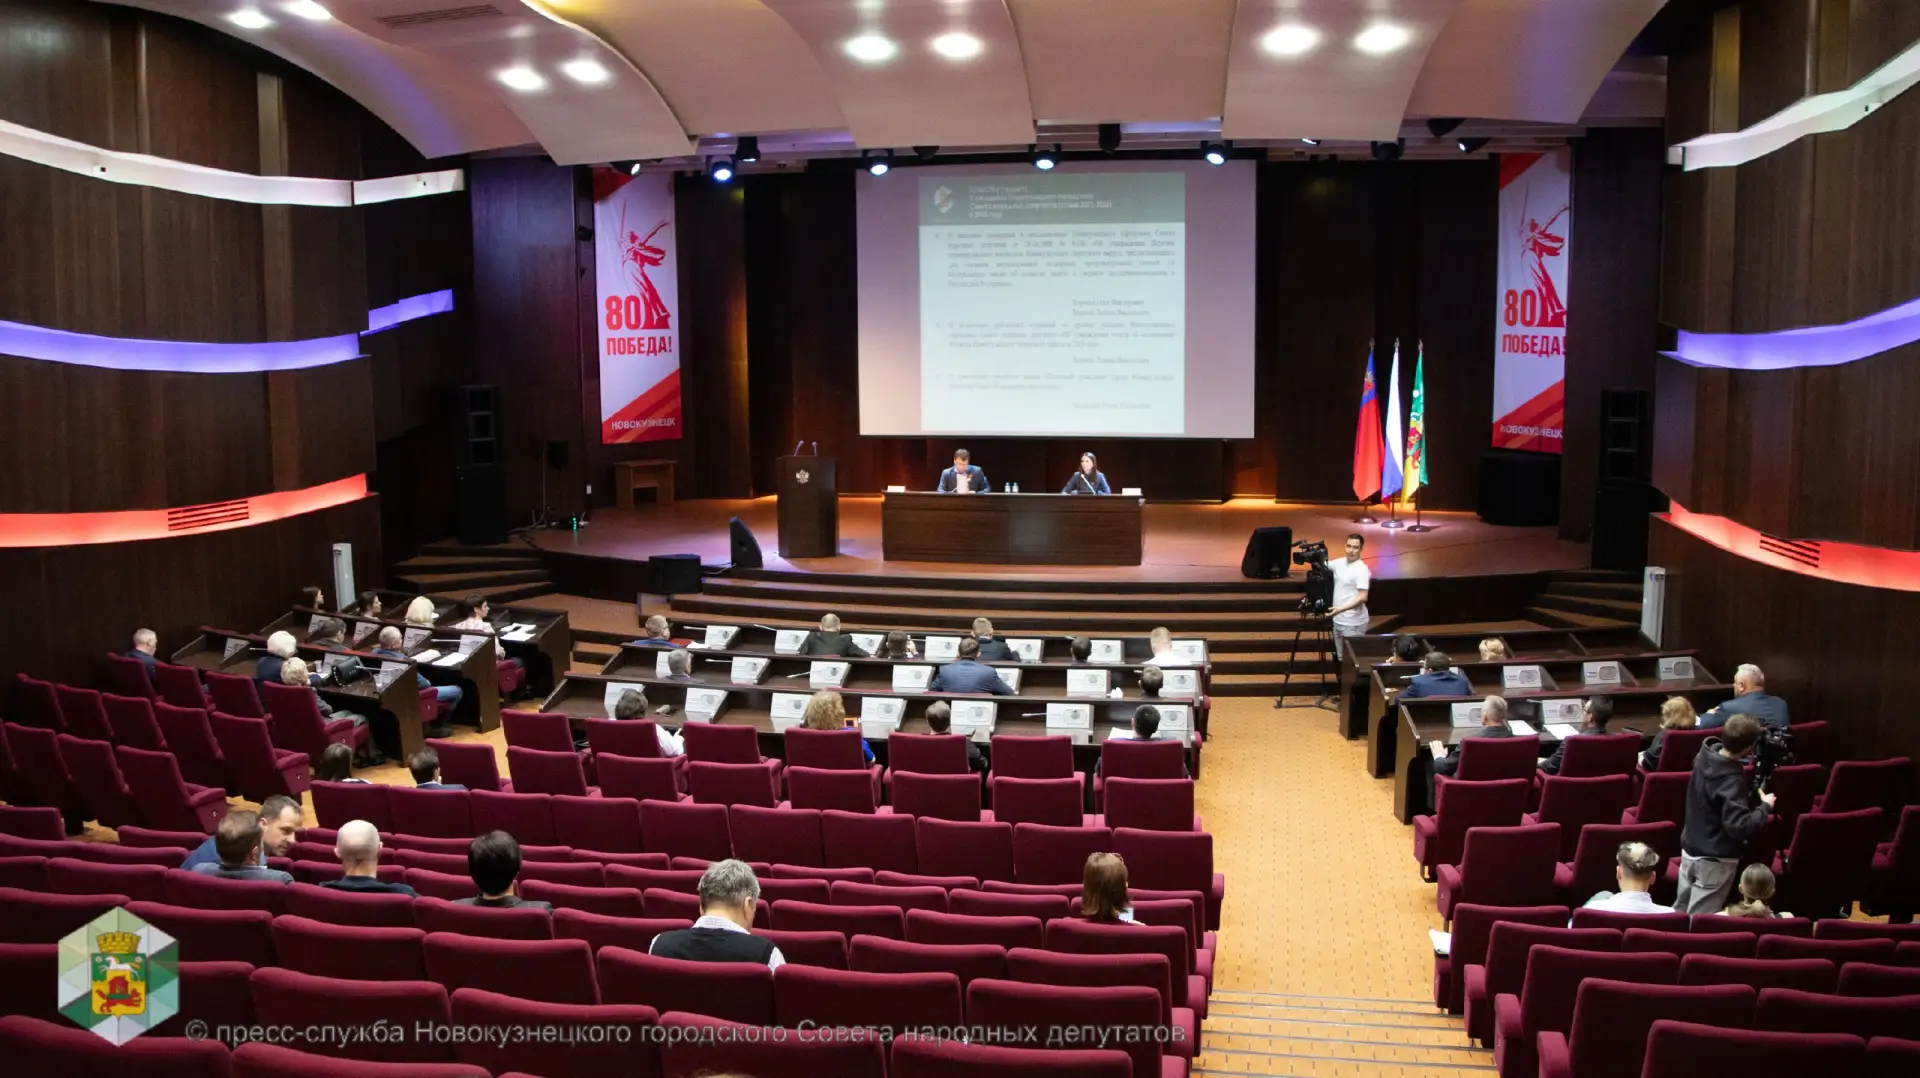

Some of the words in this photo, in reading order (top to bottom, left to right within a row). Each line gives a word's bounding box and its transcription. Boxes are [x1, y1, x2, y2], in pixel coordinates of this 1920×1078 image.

[605, 296, 641, 331] 80
[1504, 289, 1537, 327] 80
[606, 336, 672, 357] ПОБЕДА!
[1502, 333, 1566, 358] ПОБЕДА!
[611, 417, 676, 430] НОВОКУЗНЕЦК
